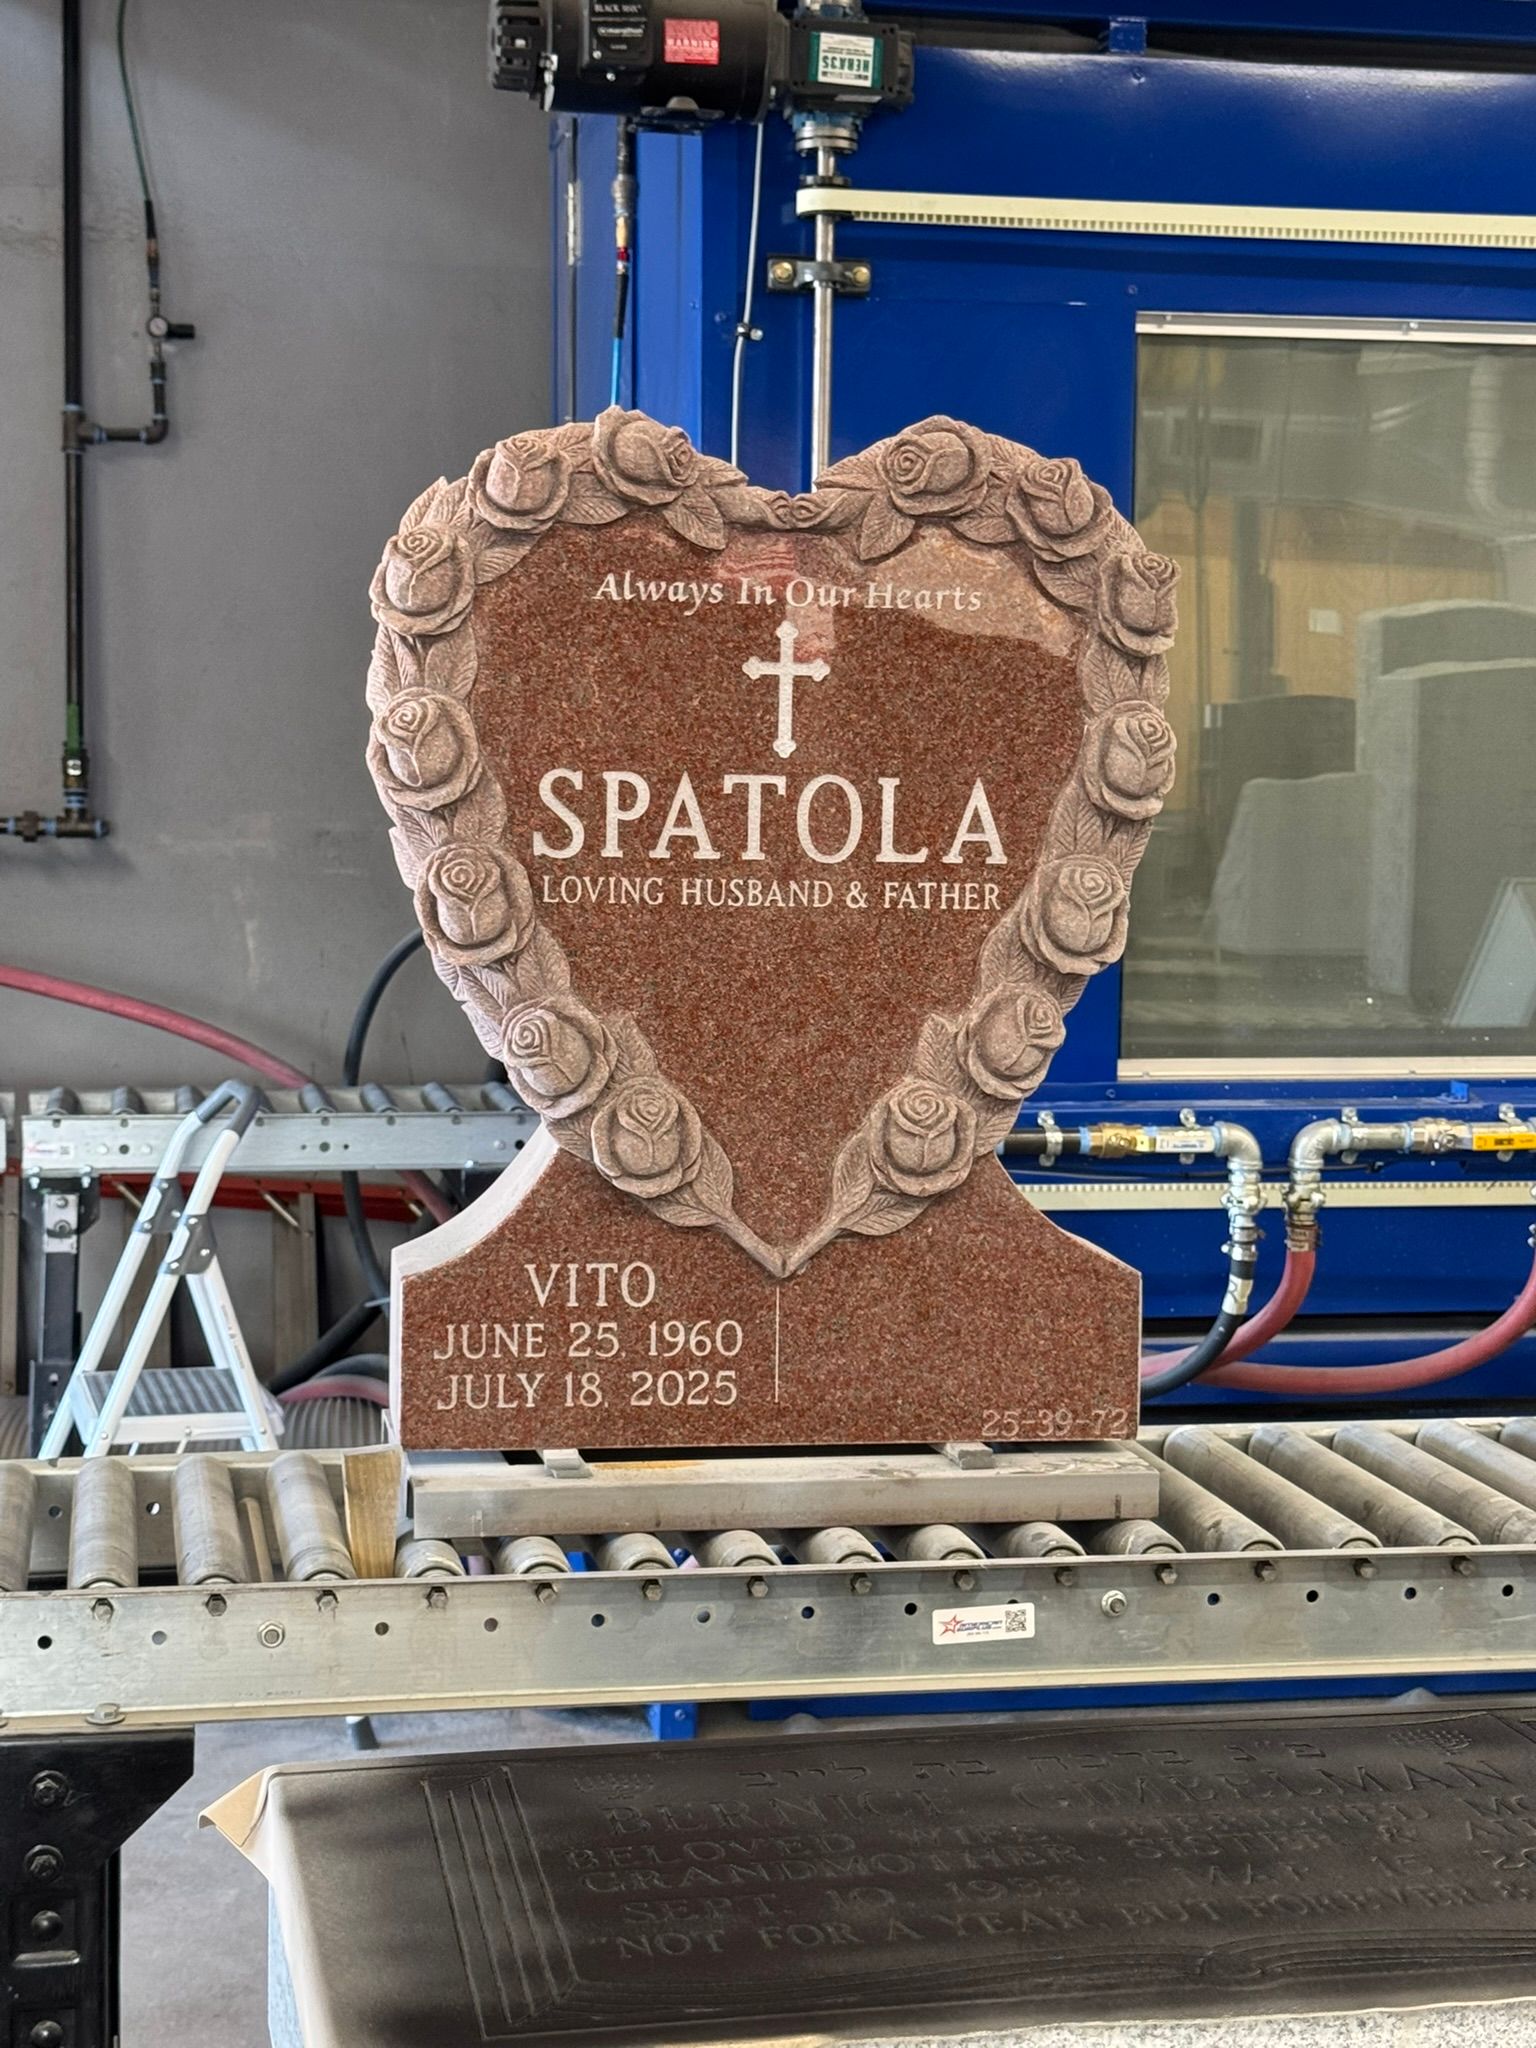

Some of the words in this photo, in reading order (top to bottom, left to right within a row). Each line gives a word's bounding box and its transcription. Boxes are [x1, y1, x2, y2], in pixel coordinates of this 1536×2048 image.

[591, 569, 725, 617] Always
[737, 576, 778, 606] In
[786, 579, 858, 608] Our
[863, 582, 983, 612] Hearts
[532, 767, 1009, 865] SPATOLA
[541, 874, 665, 905] LOVING
[680, 876, 834, 908] HUSBAND
[845, 881, 869, 910] &
[883, 880, 1002, 911] FATHER
[523, 1260, 657, 1308] VITO
[433, 1322, 548, 1360] JUNE
[648, 1319, 744, 1358] 1960
[436, 1372, 546, 1411] JULY
[629, 1369, 739, 1407] 2025
[981, 1408, 1129, 1437] 25-39-72
[601, 1788, 967, 1835] BERNICE
[562, 1832, 857, 1870] BELOVED
[757, 1923, 864, 1951] FOR
[886, 1917, 926, 1941] A
